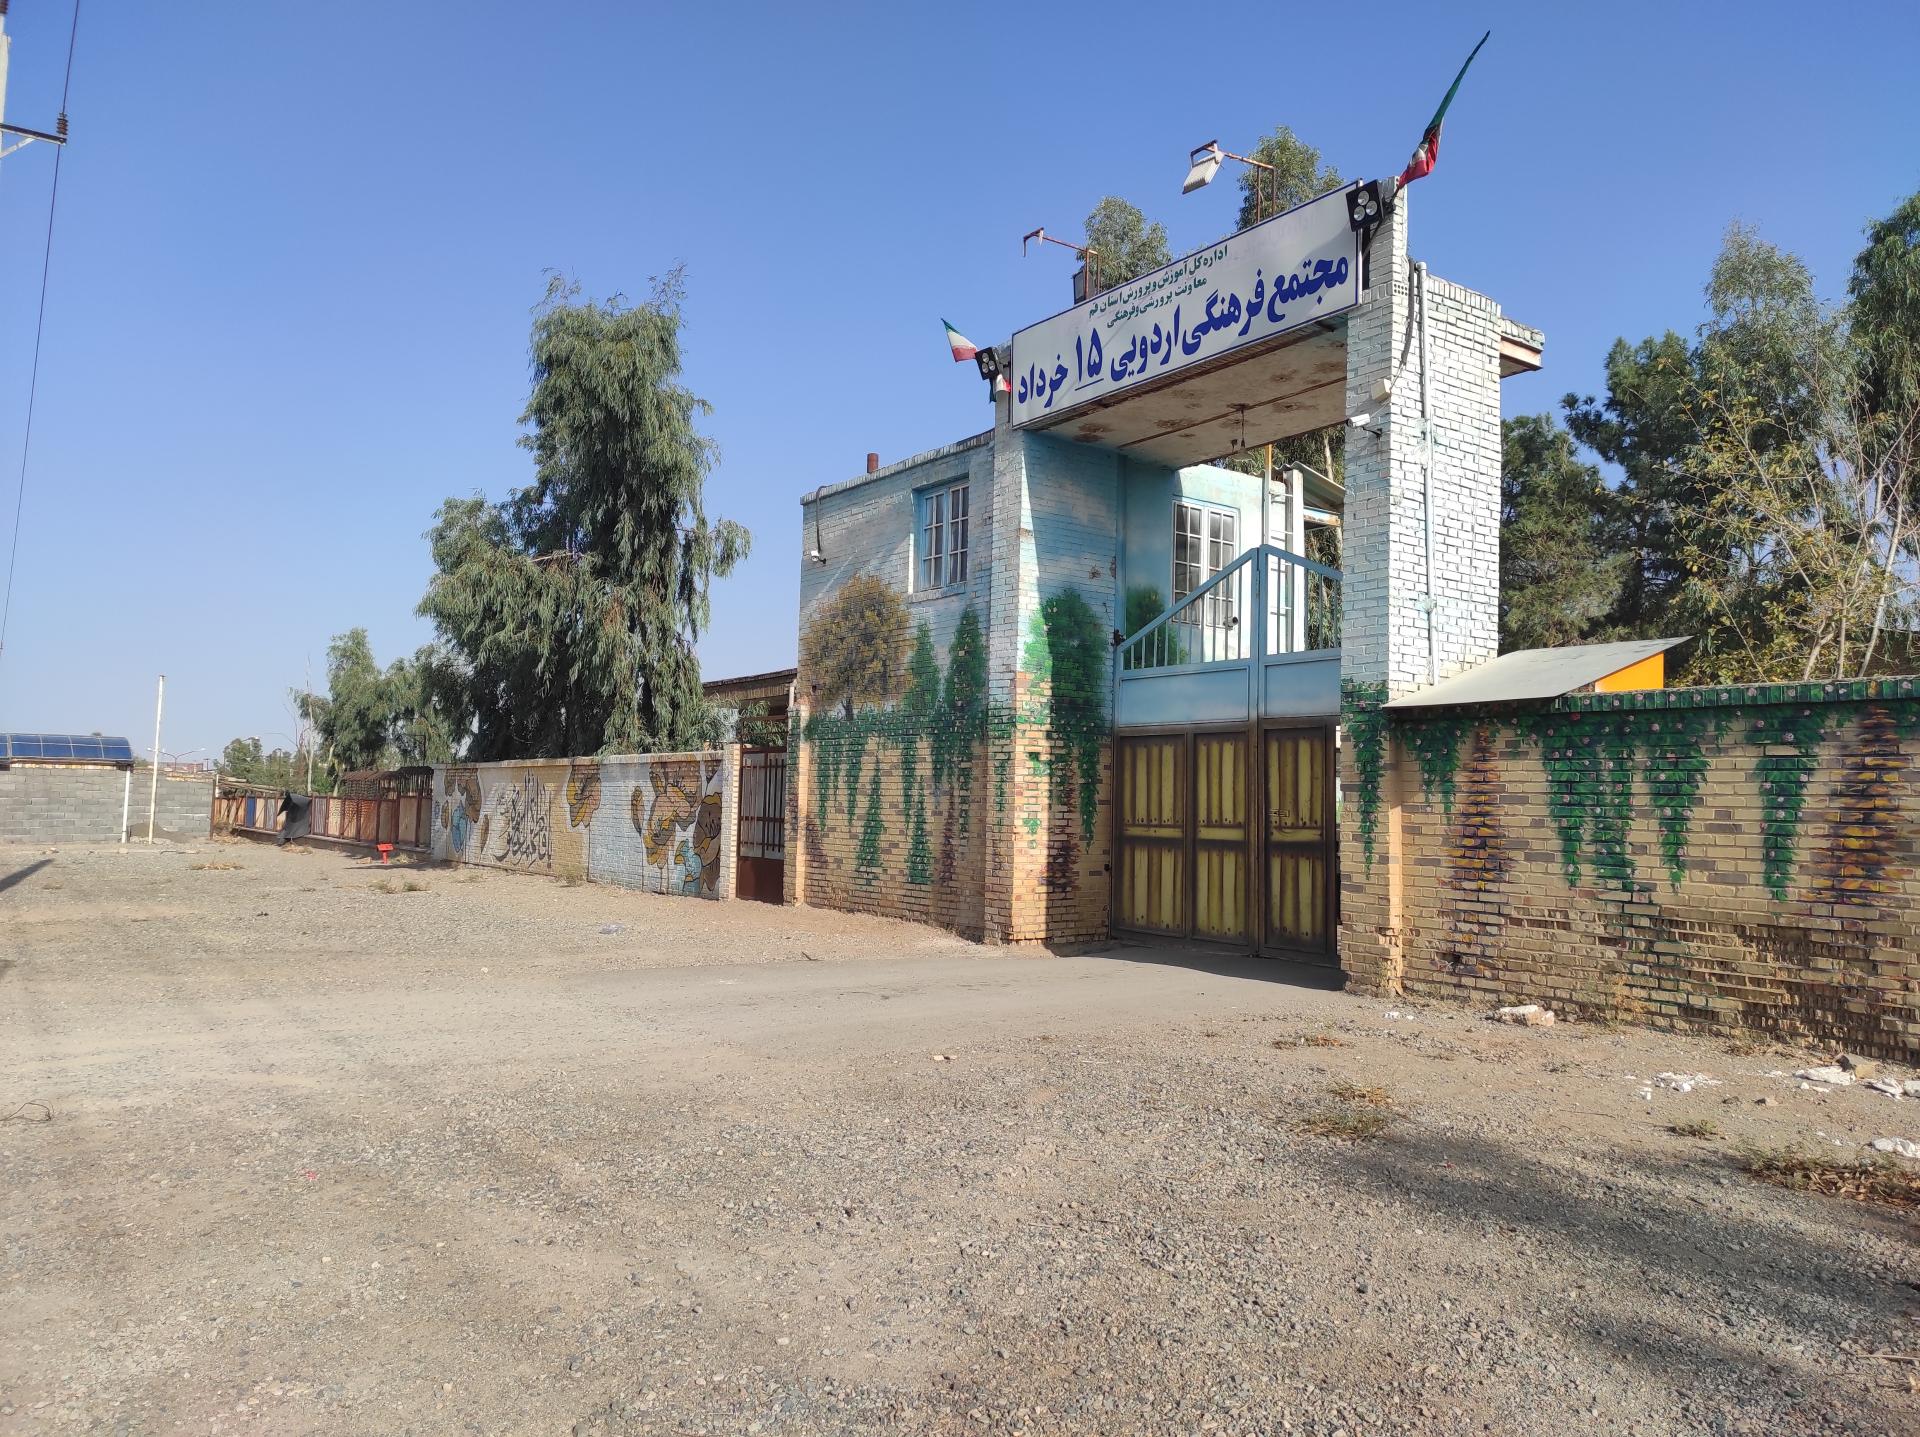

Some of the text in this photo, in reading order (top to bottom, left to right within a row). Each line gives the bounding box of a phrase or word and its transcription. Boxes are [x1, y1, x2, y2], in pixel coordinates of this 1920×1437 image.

[1189, 255, 1203, 276] کل
[1203, 244, 1229, 268] اداره
[1158, 259, 1189, 289] آموزش
[1174, 277, 1208, 297] معاونت
[1089, 302, 1099, 319] قم
[1100, 291, 1123, 313] استان
[1140, 291, 1173, 315] پرورشی
[1018, 256, 1349, 409] مجتمع فرهنگی اردویی ۱۵ خرداد
